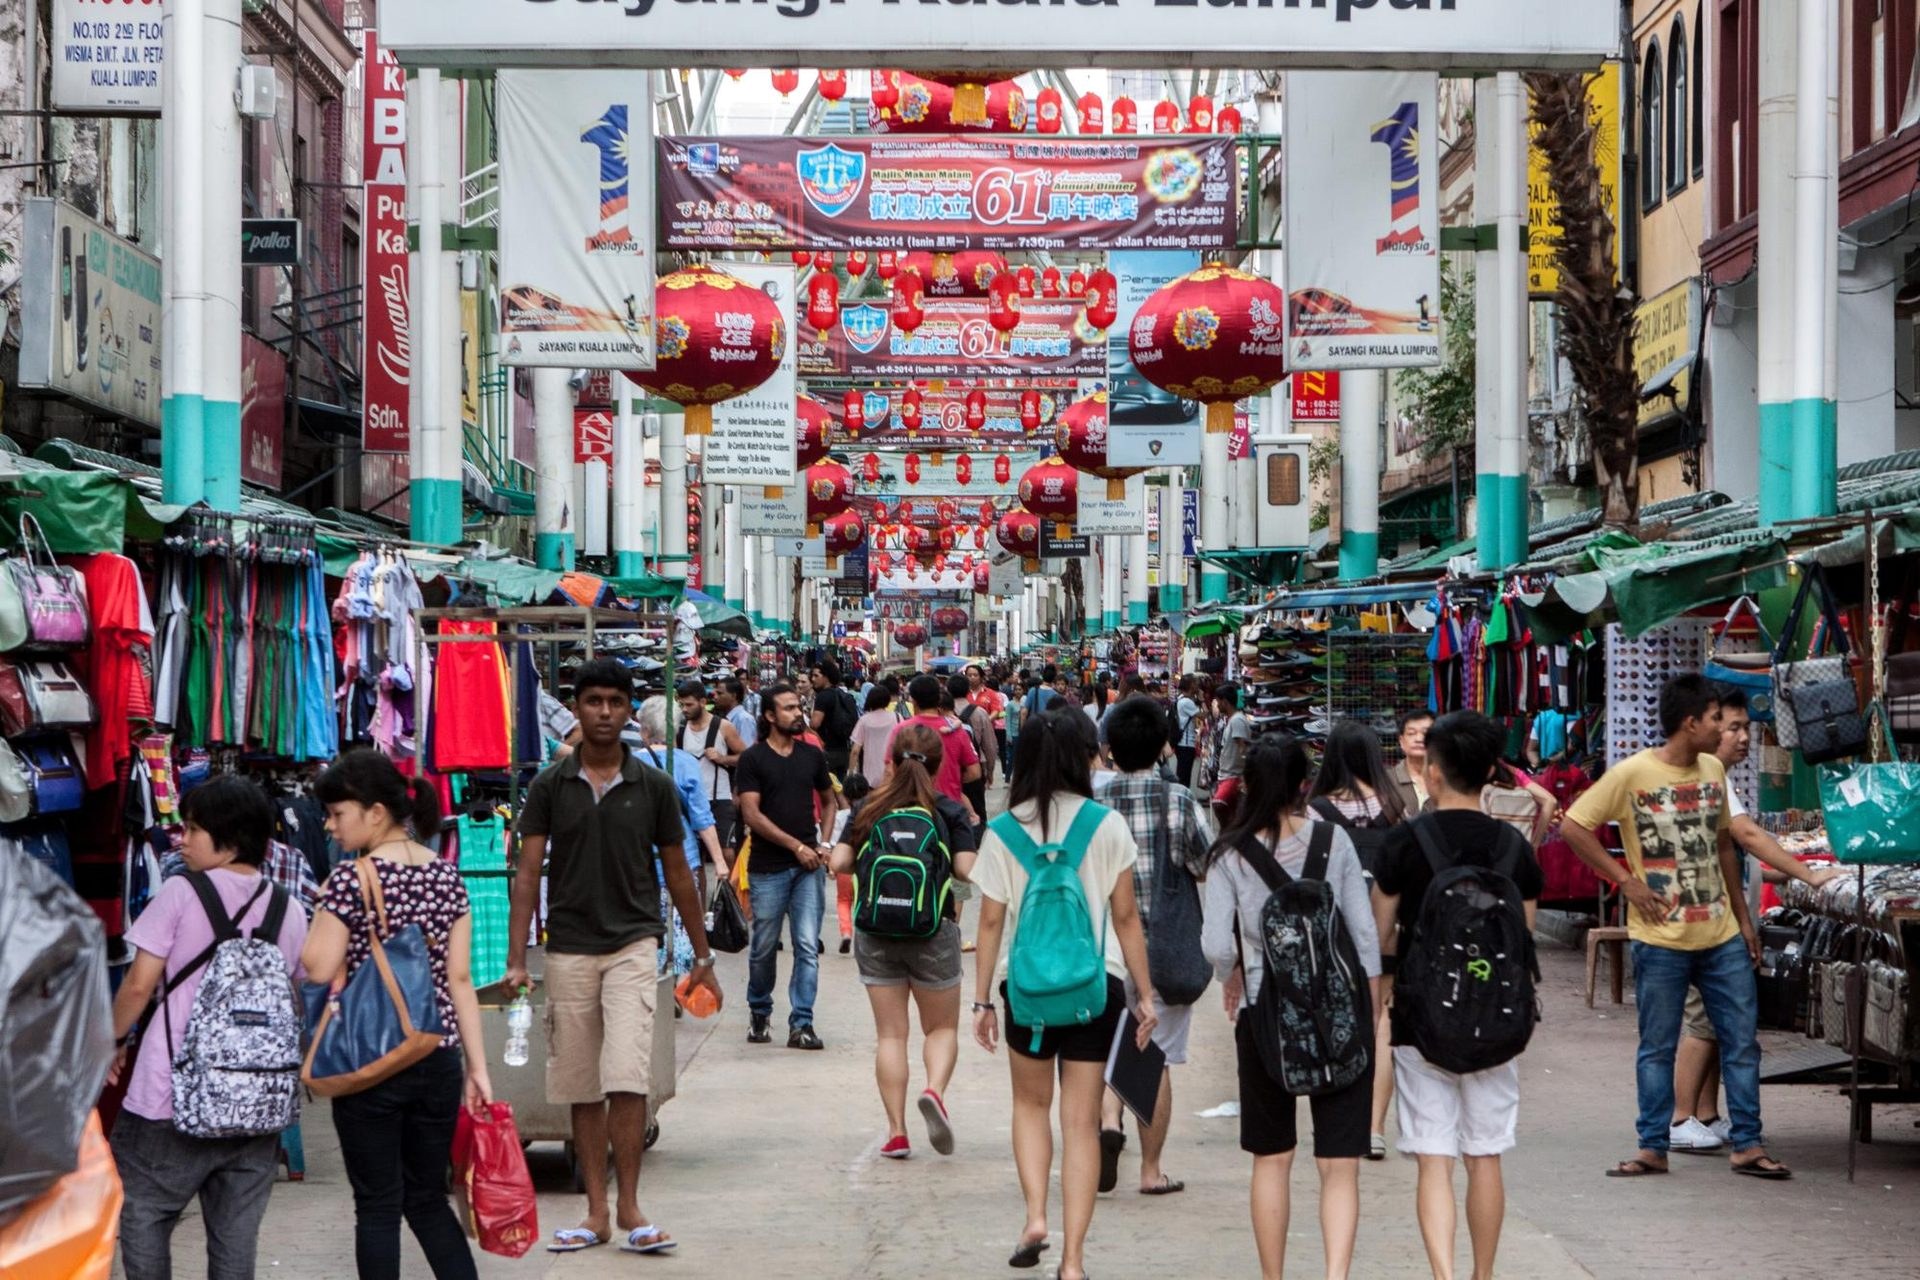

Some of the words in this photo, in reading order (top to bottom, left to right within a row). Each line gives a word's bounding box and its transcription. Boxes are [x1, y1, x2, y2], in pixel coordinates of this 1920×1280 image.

[73, 21, 110, 39] NO.103
[65, 45, 92, 62] WISMA
[91, 70, 119, 87] KUALA
[122, 70, 157, 87] LUMPUR
[383, 65, 406, 91] K
[872, 170, 903, 180] Majlis
[904, 170, 937, 180] Makan
[938, 170, 972, 180] Malam
[1053, 182, 1095, 192] Annual
[1095, 182, 1136, 192] Dinner
[870, 192, 973, 220] 歡慶成立
[1050, 193, 1139, 221] 周年晚宴
[249, 230, 292, 254] pallas
[590, 235, 640, 255] Malaysia
[848, 236, 903, 248] 16-6-2014
[1018, 236, 1066, 249] 7:30pm
[1115, 235, 1144, 248] Jalan
[1145, 235, 1188, 248] Petaling
[1380, 237, 1430, 255] Malaysia
[539, 342, 577, 353] SAYANGI
[578, 342, 608, 353] KUALA
[1328, 345, 1367, 357] SAYANGI
[1368, 345, 1399, 357] KUALA
[1401, 344, 1439, 357] LUMPUR
[1055, 365, 1075, 374] Jalan
[369, 403, 404, 429] Sdn.
[578, 412, 613, 464] AND
[742, 502, 759, 511] Your
[760, 502, 788, 511] Health,
[1081, 501, 1098, 510] Your
[1099, 501, 1127, 509] Health,
[764, 512, 776, 521] My
[777, 512, 797, 521] Glory
[1103, 510, 1114, 519] My
[1115, 509, 1136, 518] Glory
[1637, 786, 1665, 808] ONE
